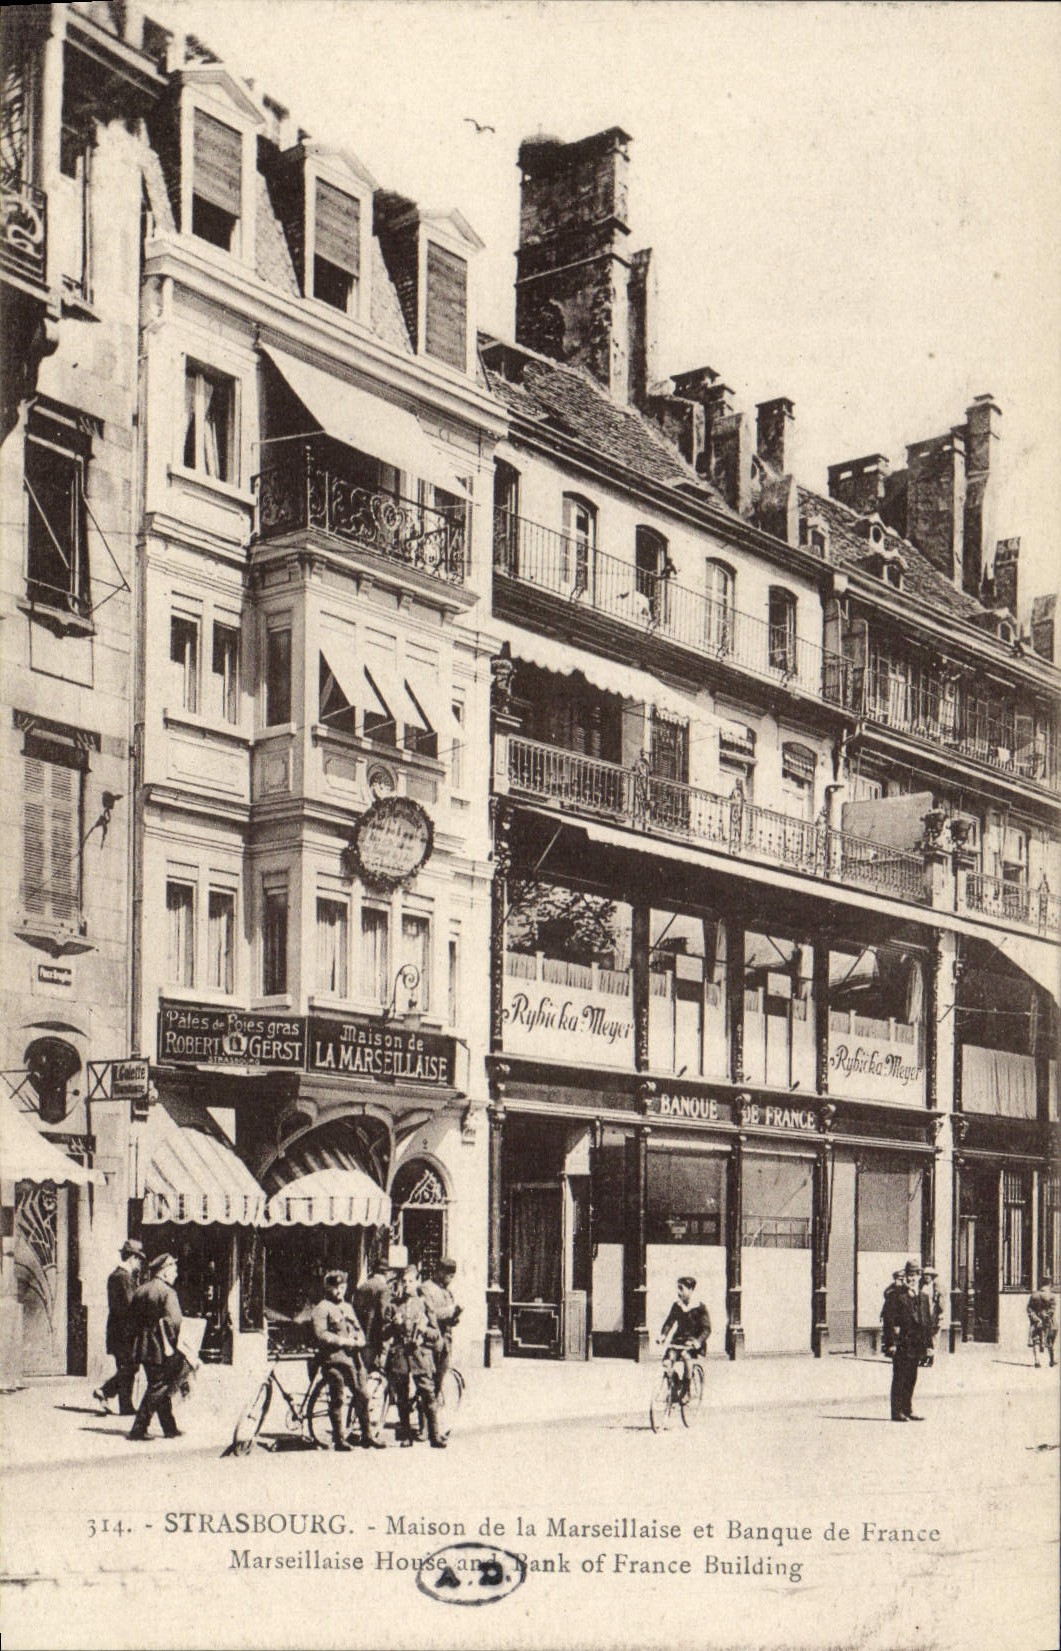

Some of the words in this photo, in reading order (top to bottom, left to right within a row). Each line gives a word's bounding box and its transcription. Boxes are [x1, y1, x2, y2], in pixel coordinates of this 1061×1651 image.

[212, 1018, 224, 1031] de
[227, 1012, 264, 1034] Foies
[267, 1021, 300, 1039] gras
[340, 1024, 402, 1048] Maison
[408, 1033, 424, 1051] de
[165, 1031, 220, 1056] ROBERT
[249, 1036, 302, 1061] GERST
[208, 1055, 260, 1065] STRASBOURG
[315, 1041, 335, 1068] LA
[338, 1044, 448, 1081] MARSEILLAISE
[660, 1093, 718, 1120] BANQUE
[765, 1105, 816, 1129] FRANCE
